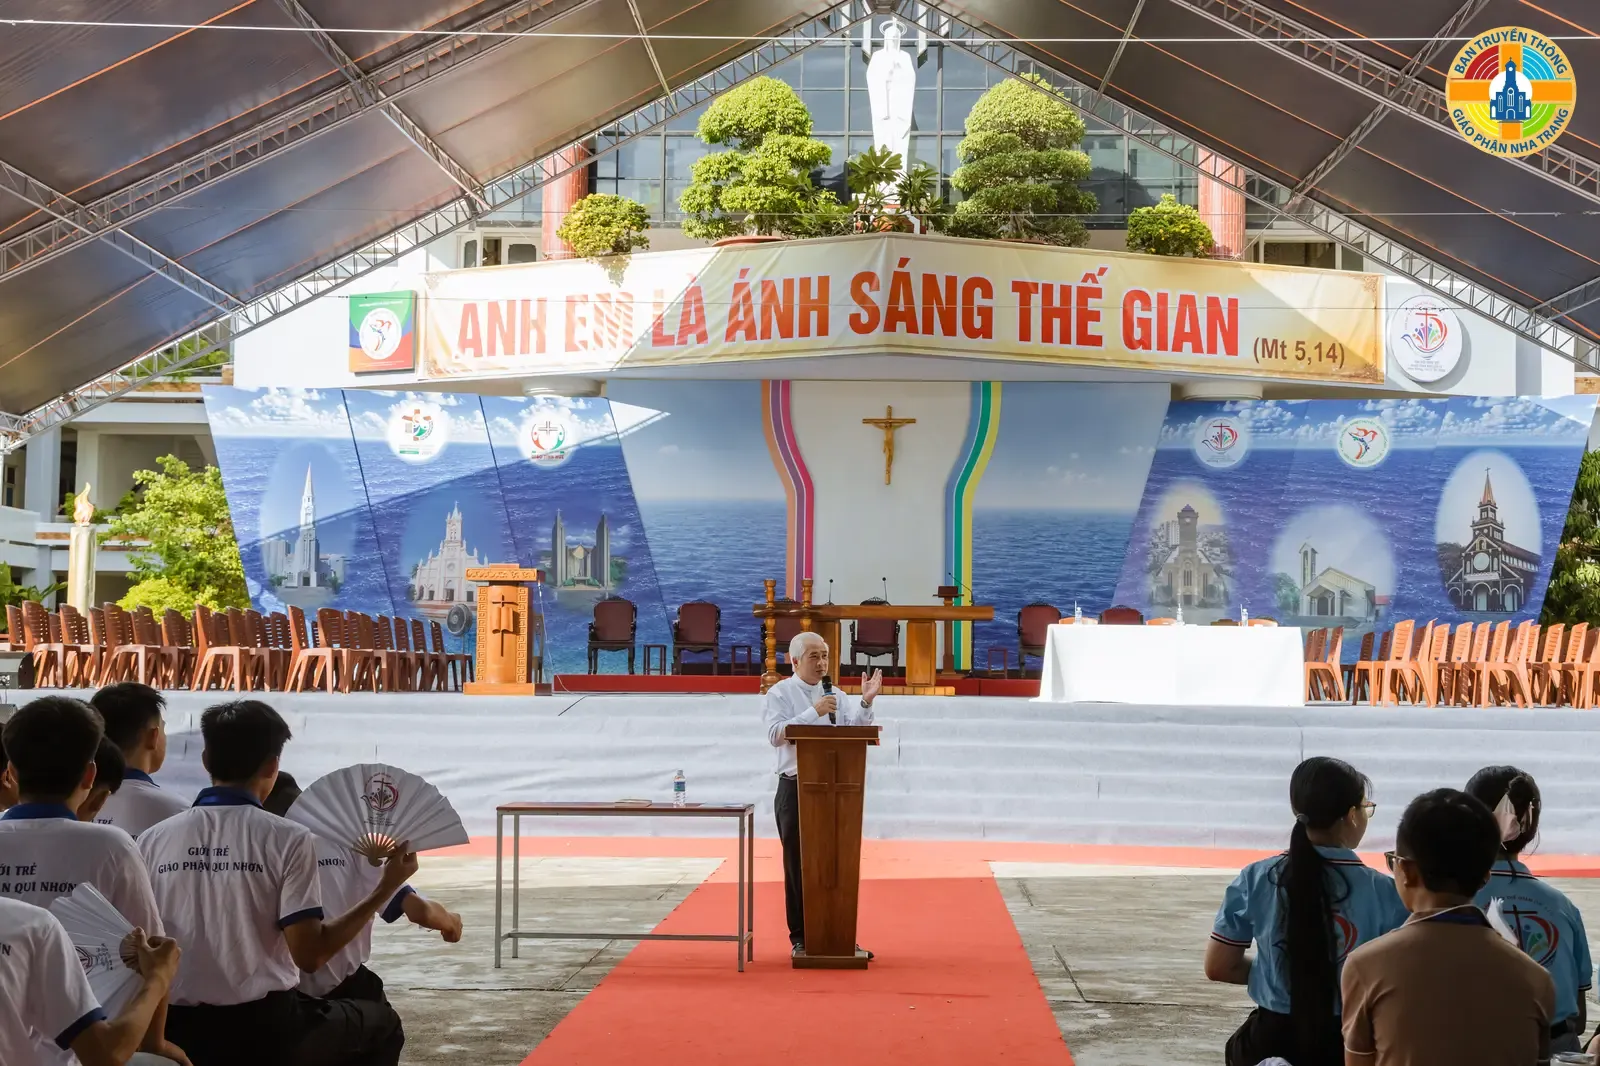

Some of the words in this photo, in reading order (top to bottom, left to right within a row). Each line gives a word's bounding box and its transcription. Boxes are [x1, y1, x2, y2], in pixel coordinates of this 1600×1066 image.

[457, 299, 547, 358] ANH
[564, 291, 634, 353] EM
[651, 272, 709, 348] LÀ
[724, 267, 830, 343] ÁNH
[848, 257, 994, 341] SÁNG
[1011, 267, 1109, 347] THẾ
[1121, 289, 1239, 357] GIAN
[1252, 337, 1288, 364] (Mt
[1294, 338, 1346, 369] 5,14)
[187, 844, 210, 857] GIỚI
[212, 845, 230, 857] TRẺ
[15, 862, 37, 876] TRẺ
[158, 860, 179, 874] GIÁO
[182, 859, 210, 873] PHẬN
[211, 861, 229, 873] QUI
[232, 861, 264, 873] NHƠN
[317, 857, 345, 868] NHƠN
[15, 881, 37, 894] QUI
[40, 881, 77, 893] NHƠN
